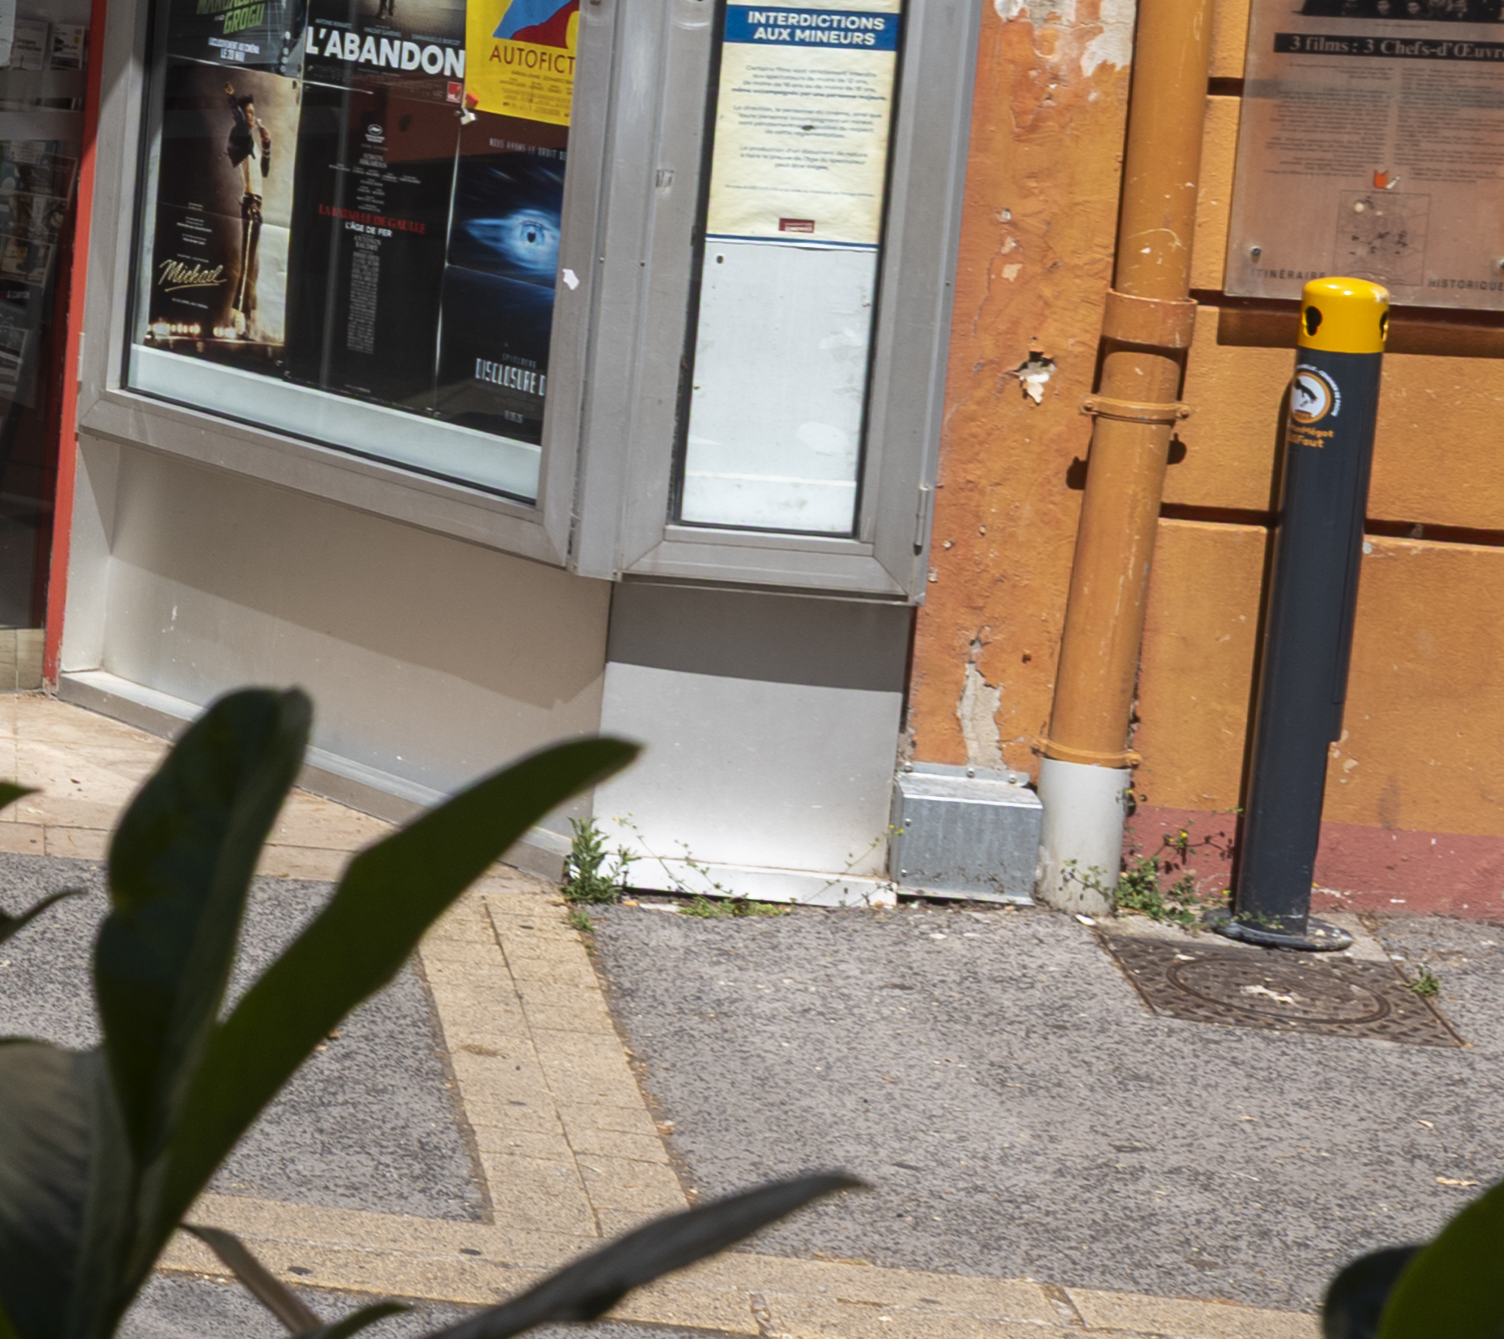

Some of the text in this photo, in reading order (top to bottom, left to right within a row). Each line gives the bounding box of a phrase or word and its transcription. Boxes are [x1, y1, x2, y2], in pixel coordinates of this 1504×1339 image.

[223, 4, 264, 34] GROGU
[748, 11, 885, 31] INTERDICTIONS
[753, 27, 876, 45] AUX MINEURS
[1290, 36, 1300, 50] 3
[1363, 39, 1374, 52] 3
[305, 27, 465, 78] L'ABANDON
[489, 45, 576, 74] AUTOFICT
[387, 215, 425, 234] GAULLE
[158, 259, 228, 285] Michael
[1429, 280, 1504, 291] HISTORIQUE
